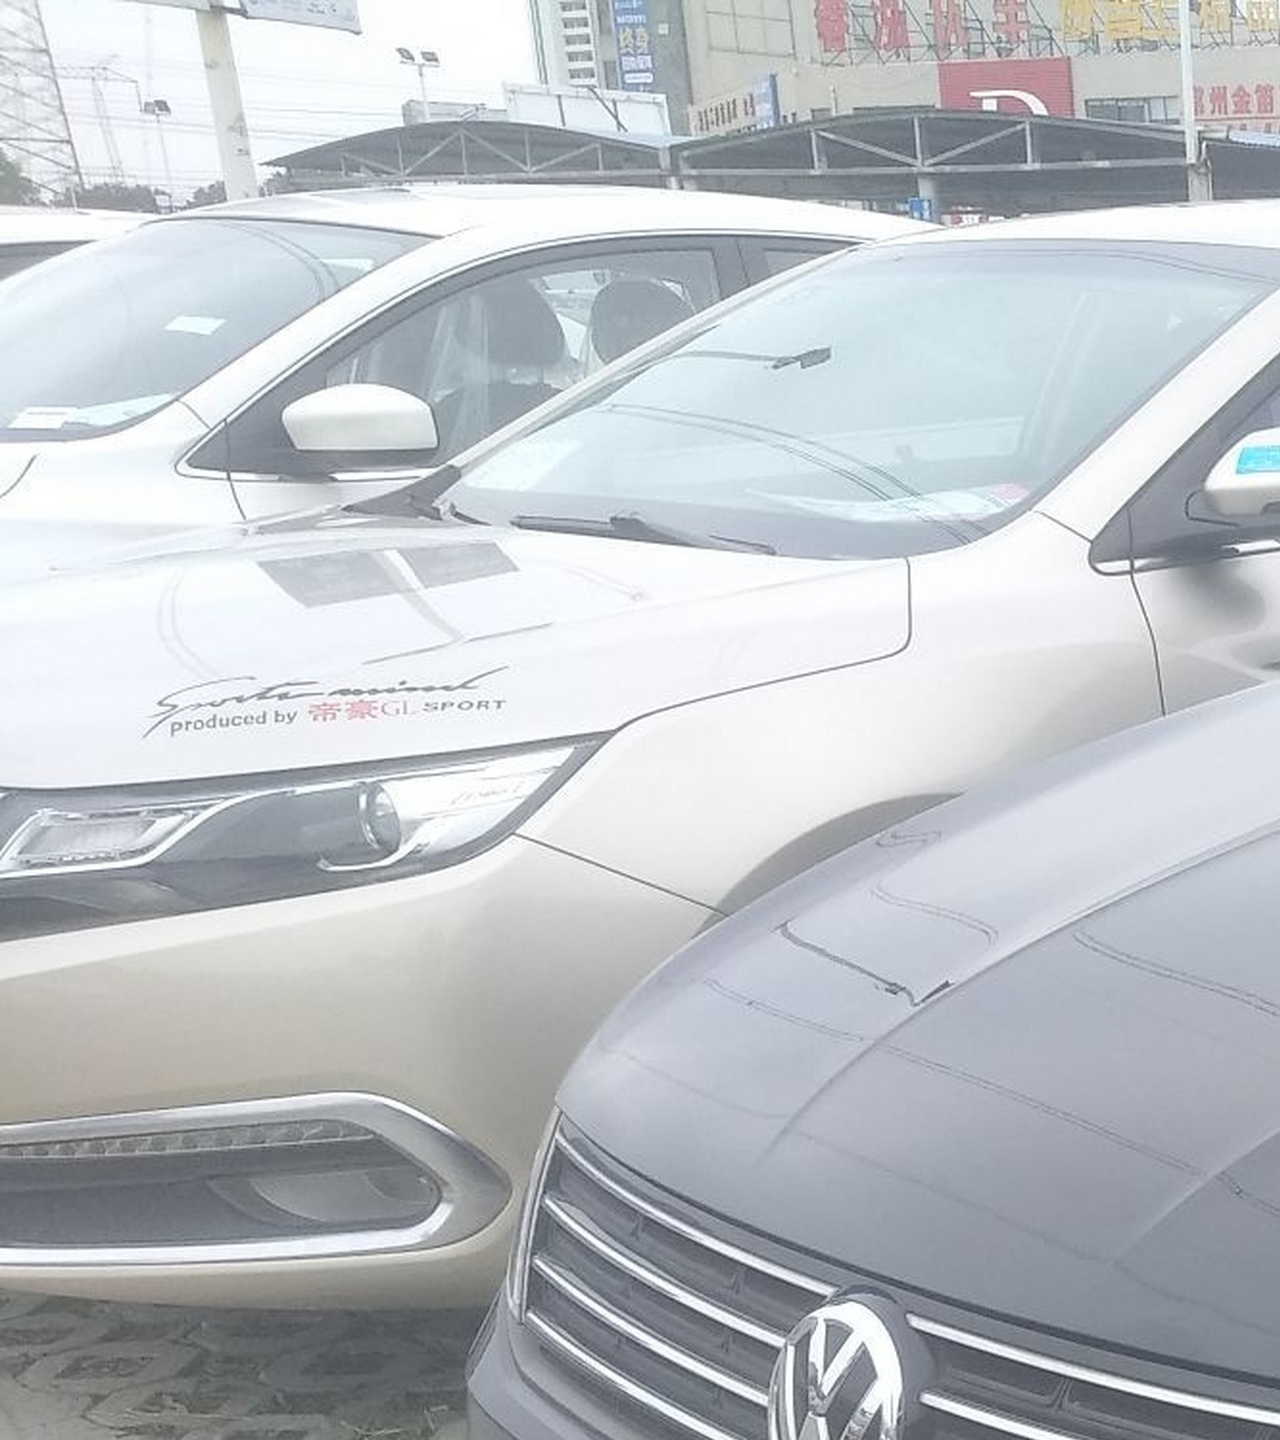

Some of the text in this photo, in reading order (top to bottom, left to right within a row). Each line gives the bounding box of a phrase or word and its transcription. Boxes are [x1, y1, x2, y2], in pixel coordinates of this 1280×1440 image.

[169, 713, 268, 738] produced
[273, 708, 297, 726] by
[423, 699, 507, 714] SPORT
